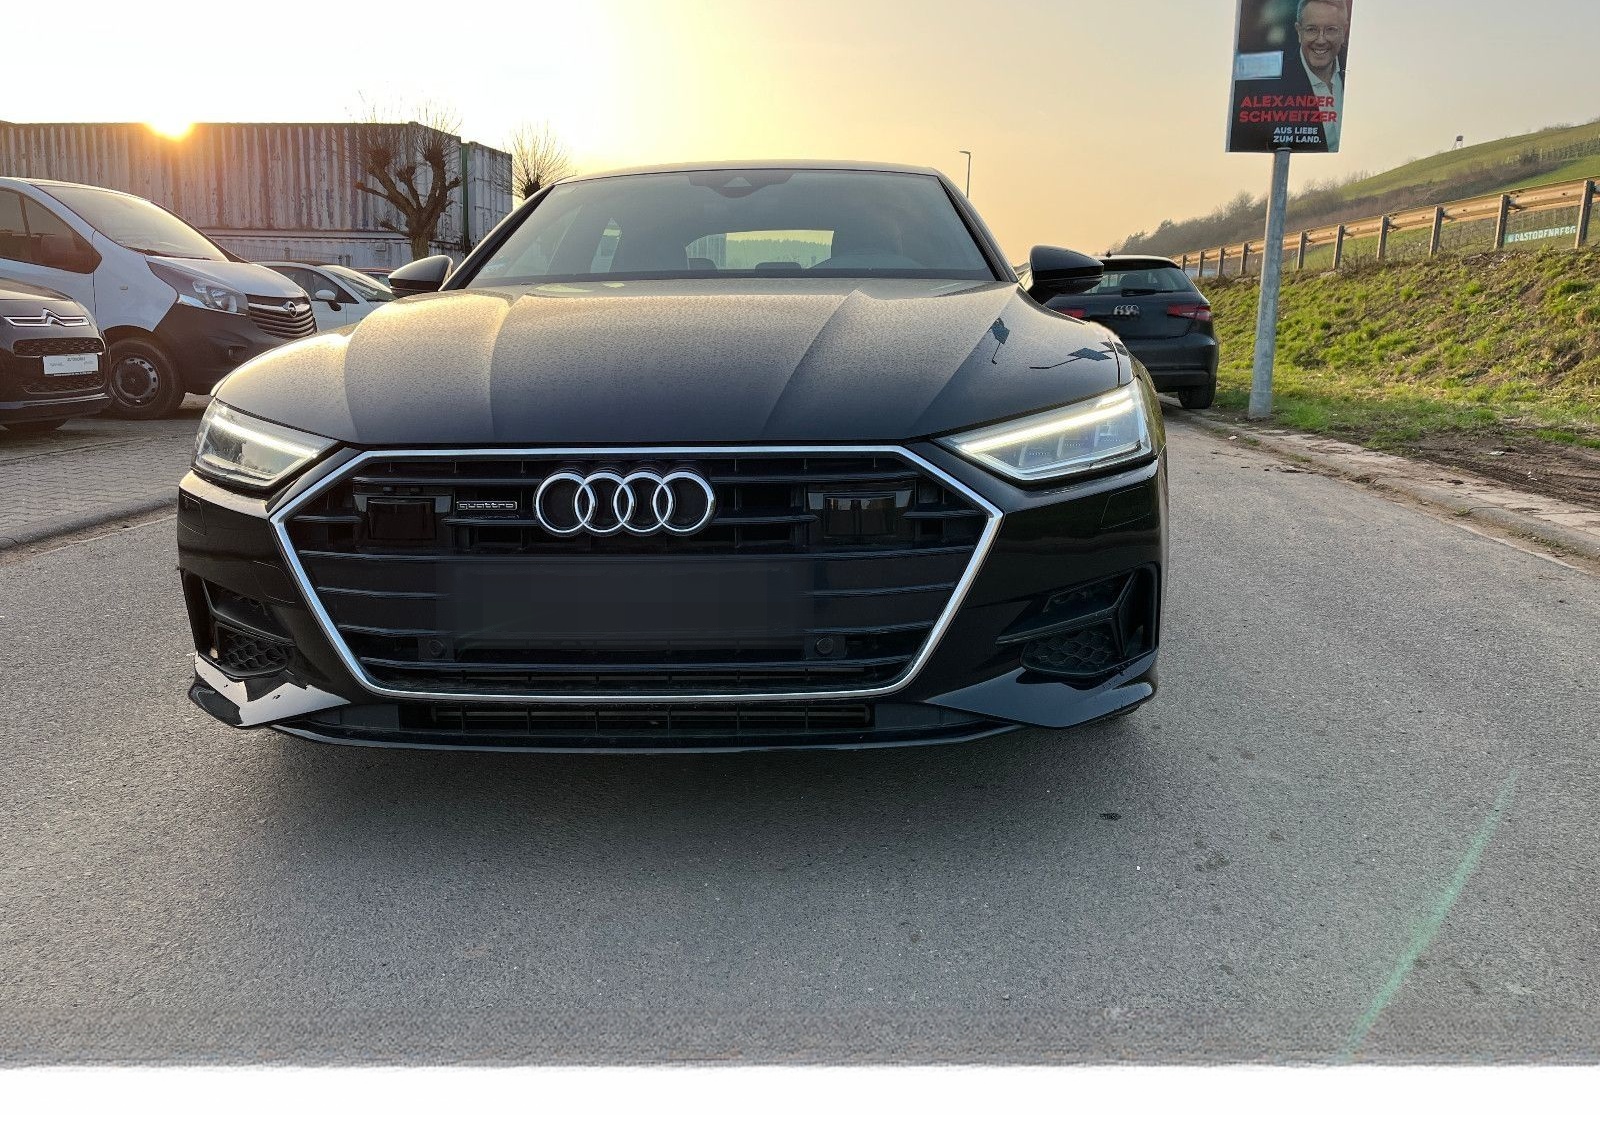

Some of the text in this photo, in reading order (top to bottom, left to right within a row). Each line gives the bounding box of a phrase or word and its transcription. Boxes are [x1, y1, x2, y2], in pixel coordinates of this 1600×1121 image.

[1241, 96, 1335, 107] ALEXANDER
[1240, 110, 1337, 122] SCHWEITZER
[1273, 135, 1322, 143] ZUM LAND.
[459, 502, 514, 510] quattro
